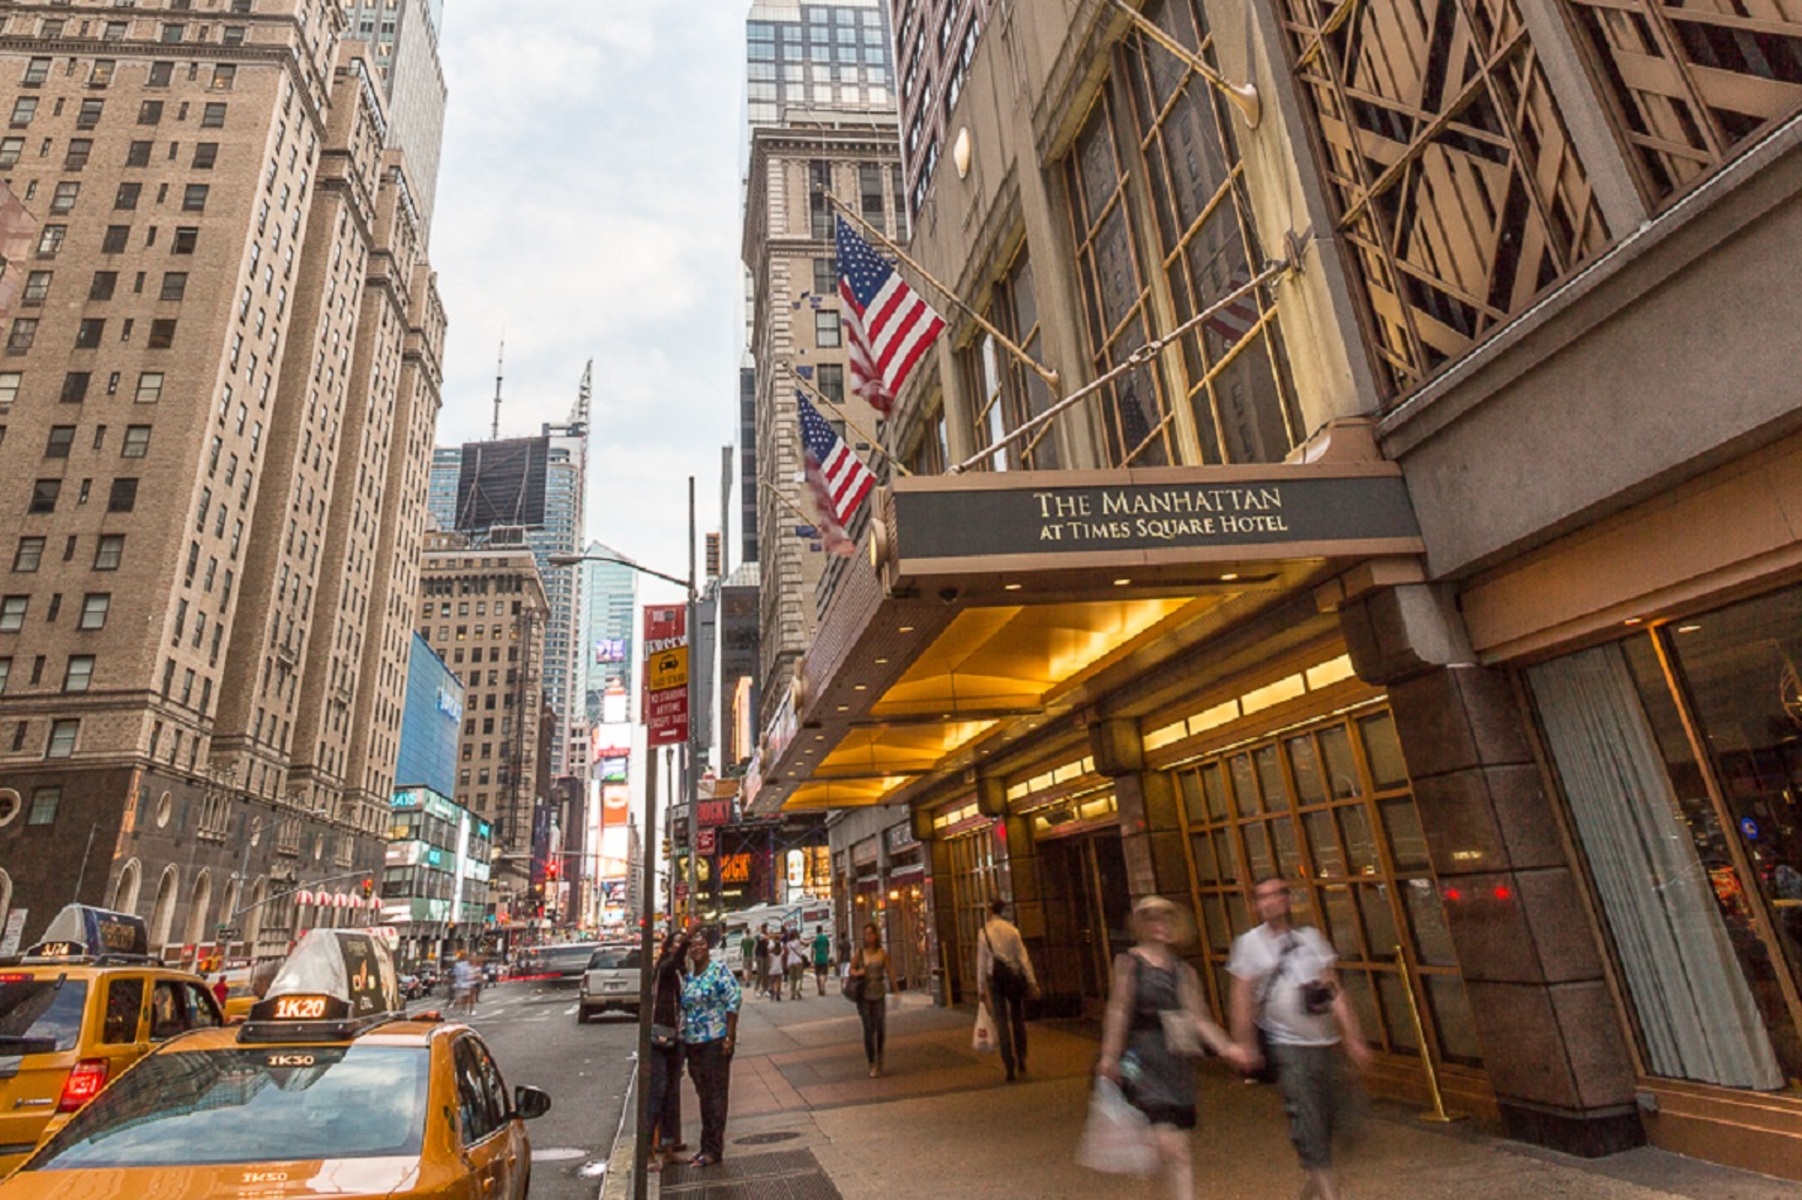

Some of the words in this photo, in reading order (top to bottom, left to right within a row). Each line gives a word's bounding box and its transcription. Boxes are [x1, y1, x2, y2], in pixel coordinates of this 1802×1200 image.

[1033, 491, 1092, 518] THE
[1102, 487, 1283, 515] MANHATTAN
[1040, 523, 1064, 541] AT
[1067, 520, 1130, 540] TIMES
[1136, 517, 1216, 541] SQUARE
[1220, 514, 1289, 533] HOTEL
[274, 999, 327, 1018] 1K20
